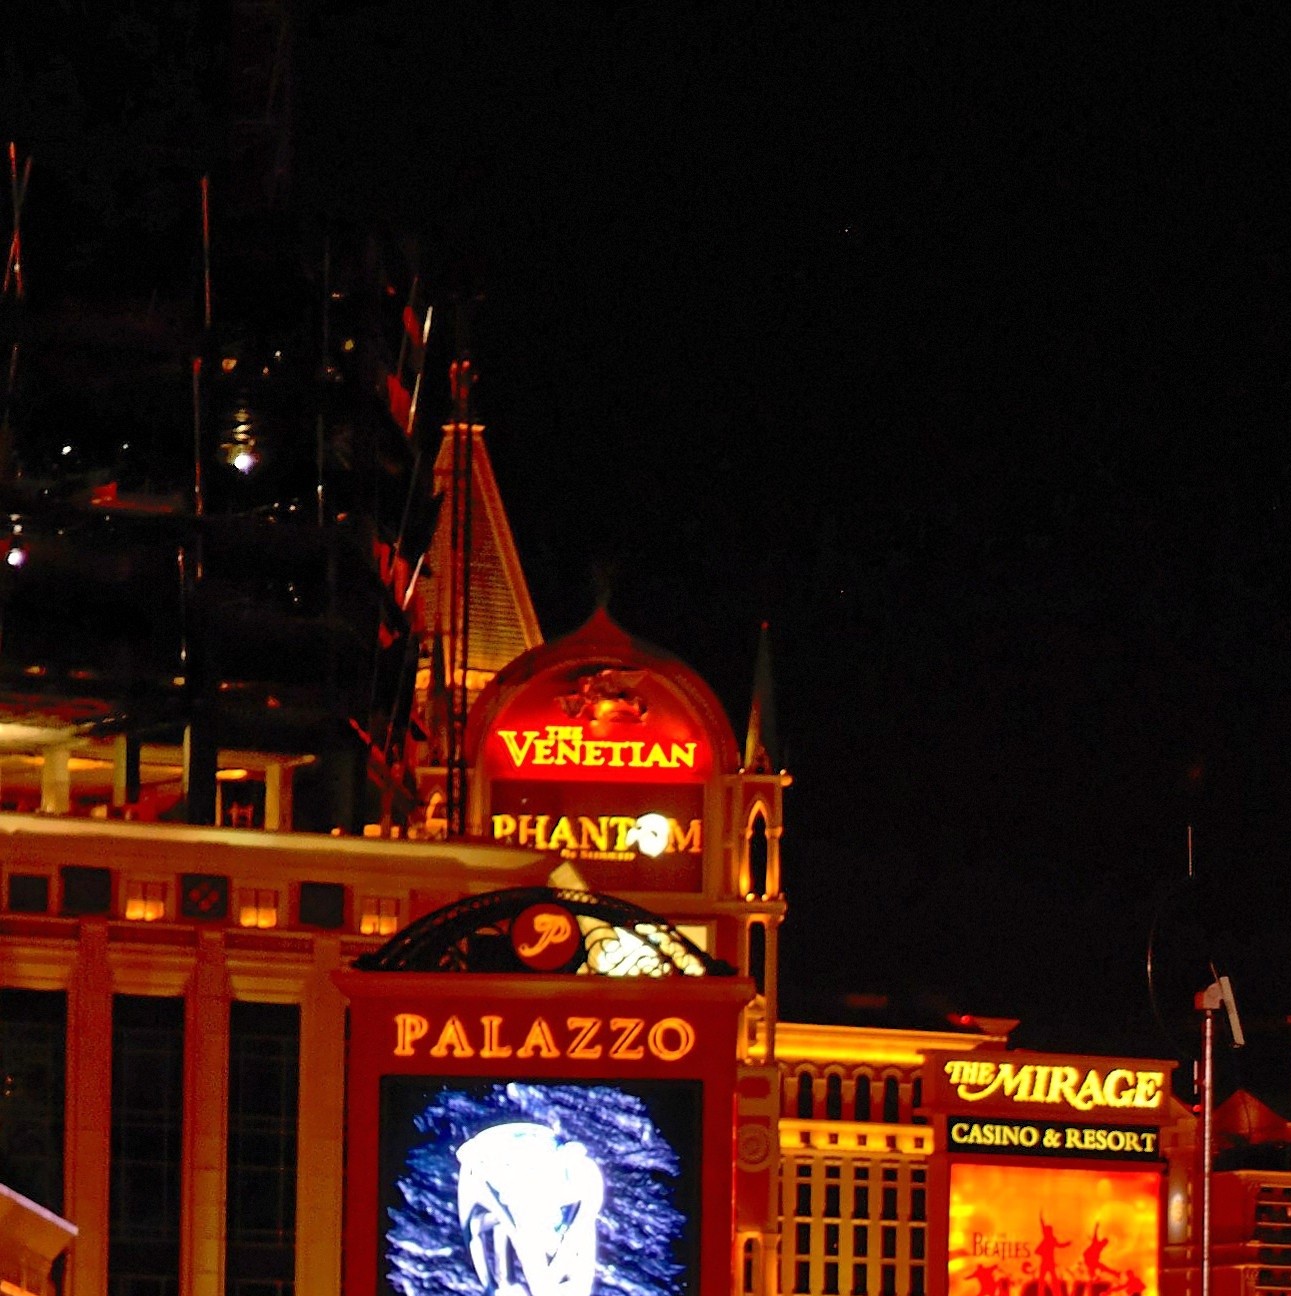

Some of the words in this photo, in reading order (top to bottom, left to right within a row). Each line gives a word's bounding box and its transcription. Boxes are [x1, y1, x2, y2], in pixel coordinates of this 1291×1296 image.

[497, 729, 697, 768] VENETIAN
[545, 726, 583, 741] THE
[393, 1013, 696, 1062] PALAZZO
[944, 1060, 996, 1085] THE
[957, 1063, 1164, 1111] MIRAGE
[951, 1122, 1039, 1148] CASINO
[1042, 1127, 1062, 1149] &
[1065, 1127, 1157, 1153] RESORT
[972, 1231, 1032, 1262] BEATLES
